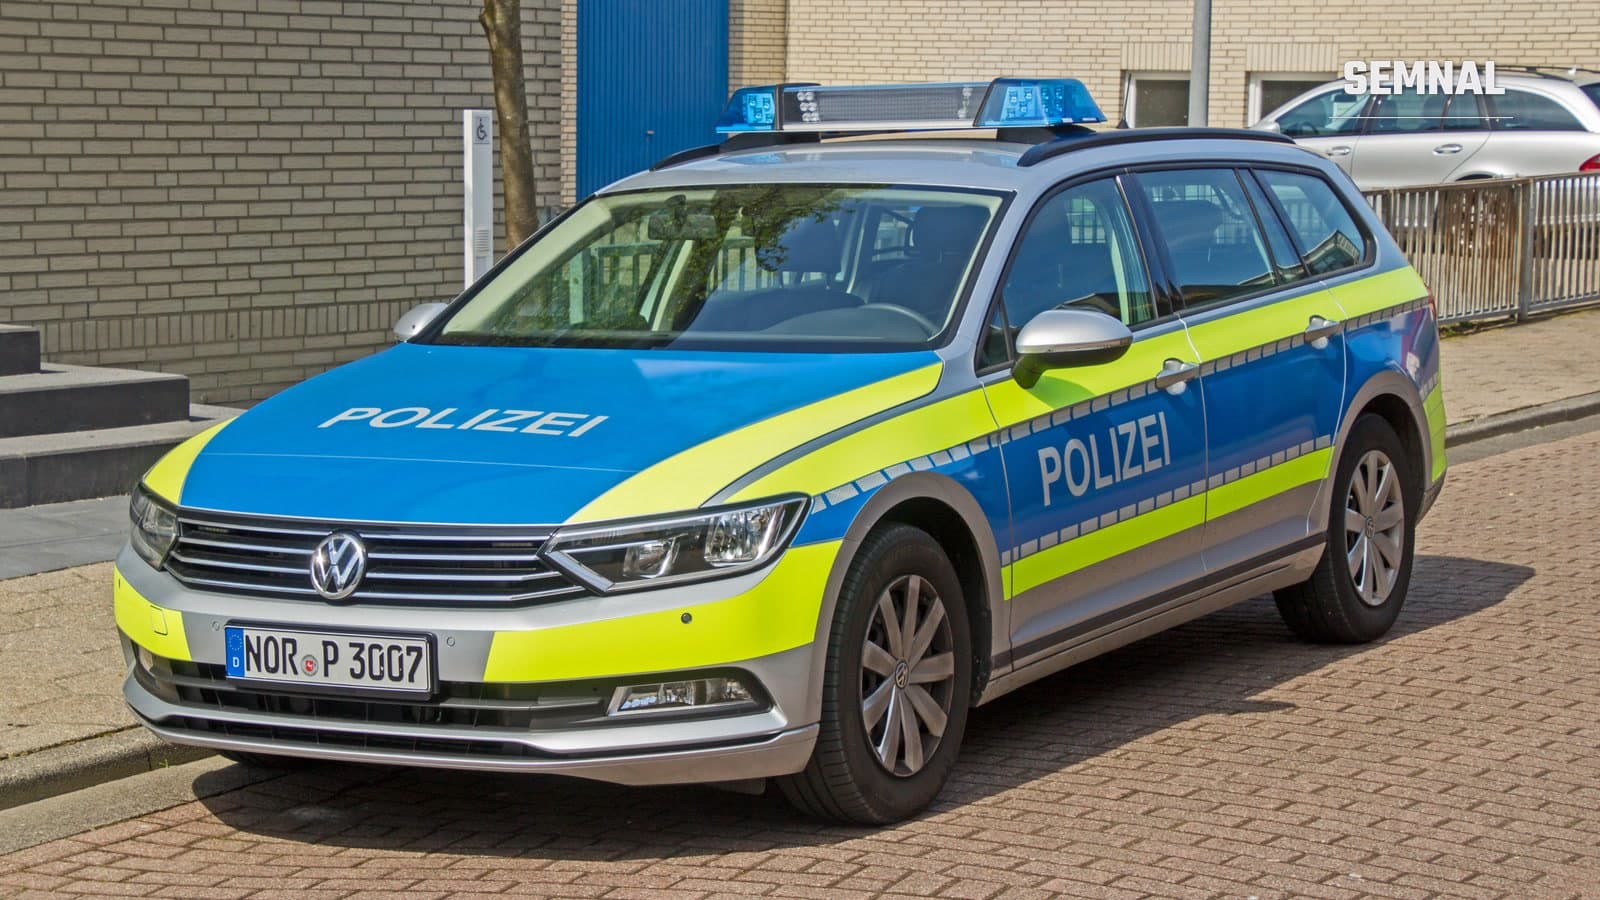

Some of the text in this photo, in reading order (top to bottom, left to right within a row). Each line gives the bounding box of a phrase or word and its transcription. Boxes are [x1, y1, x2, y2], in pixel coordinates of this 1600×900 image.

[317, 407, 610, 437] POLIZEI
[1038, 411, 1171, 507] POLIZEI
[313, 535, 364, 598] VW
[232, 634, 423, 683] D NOR P 3007
